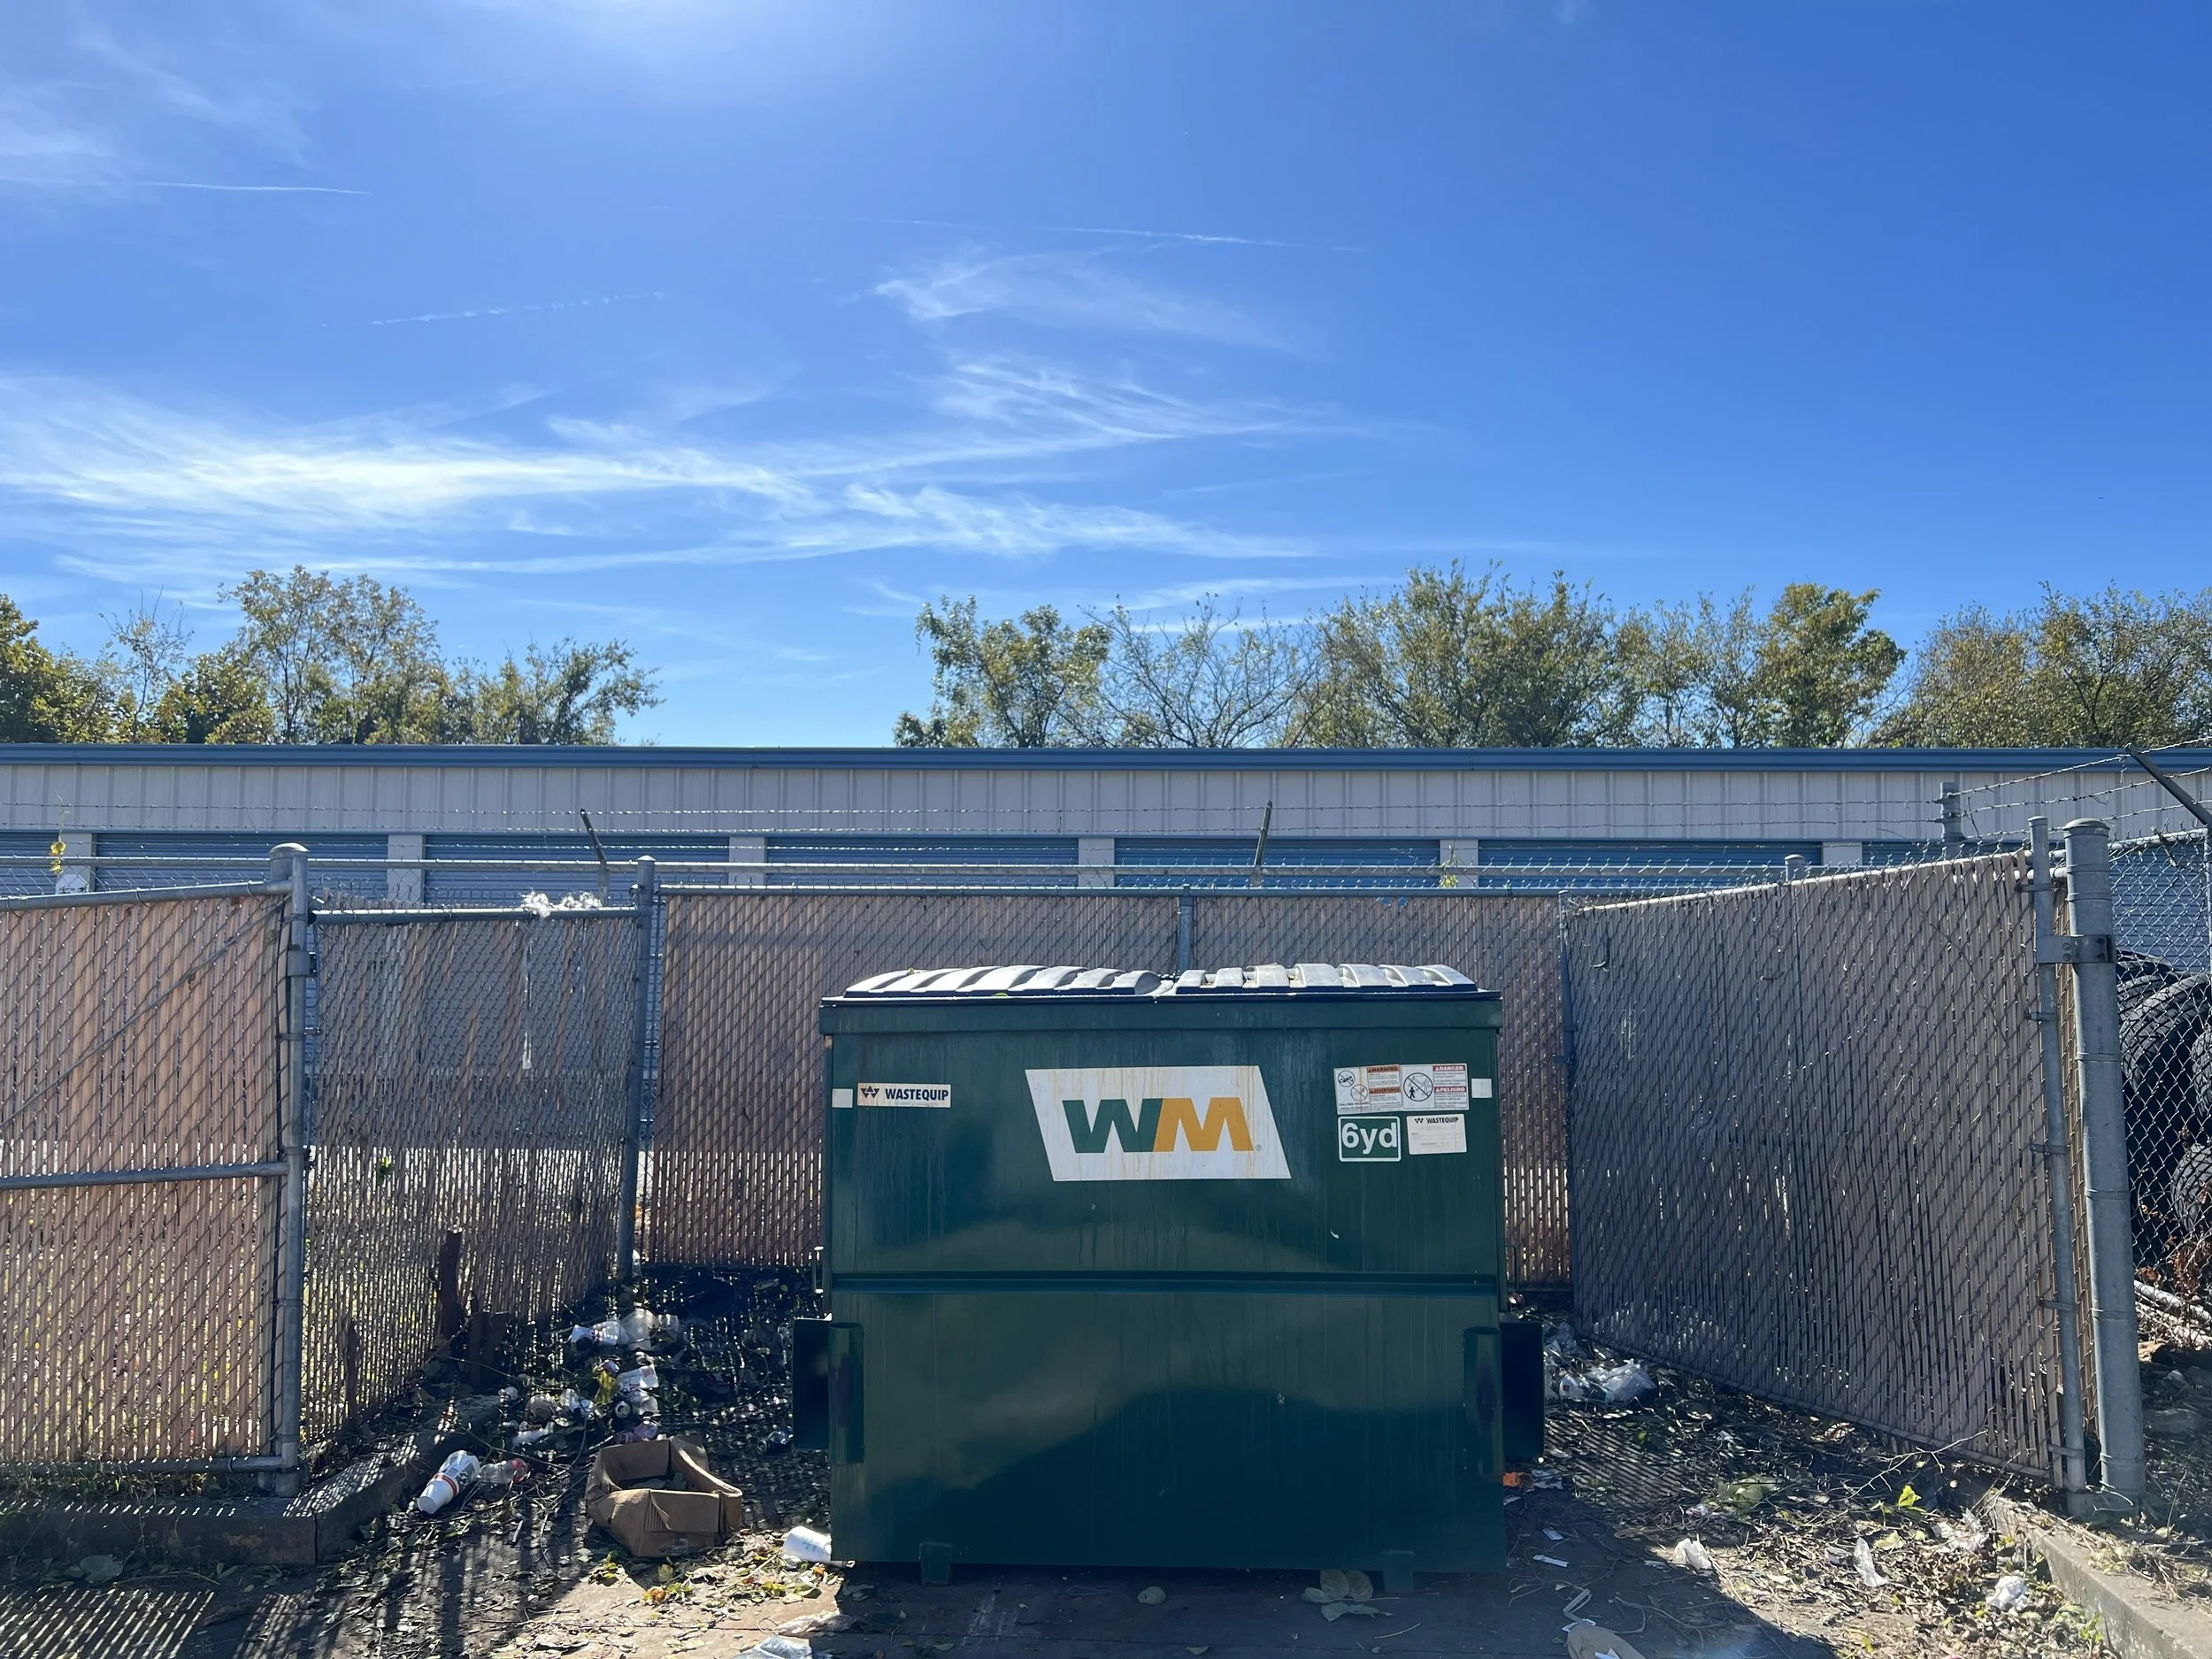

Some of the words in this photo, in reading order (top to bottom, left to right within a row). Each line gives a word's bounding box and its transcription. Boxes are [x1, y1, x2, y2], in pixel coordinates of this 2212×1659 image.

[885, 1088, 949, 1101] WASTEQUIP
[1062, 1097, 1254, 1153] WM
[1341, 1122, 1398, 1155] 6yd
